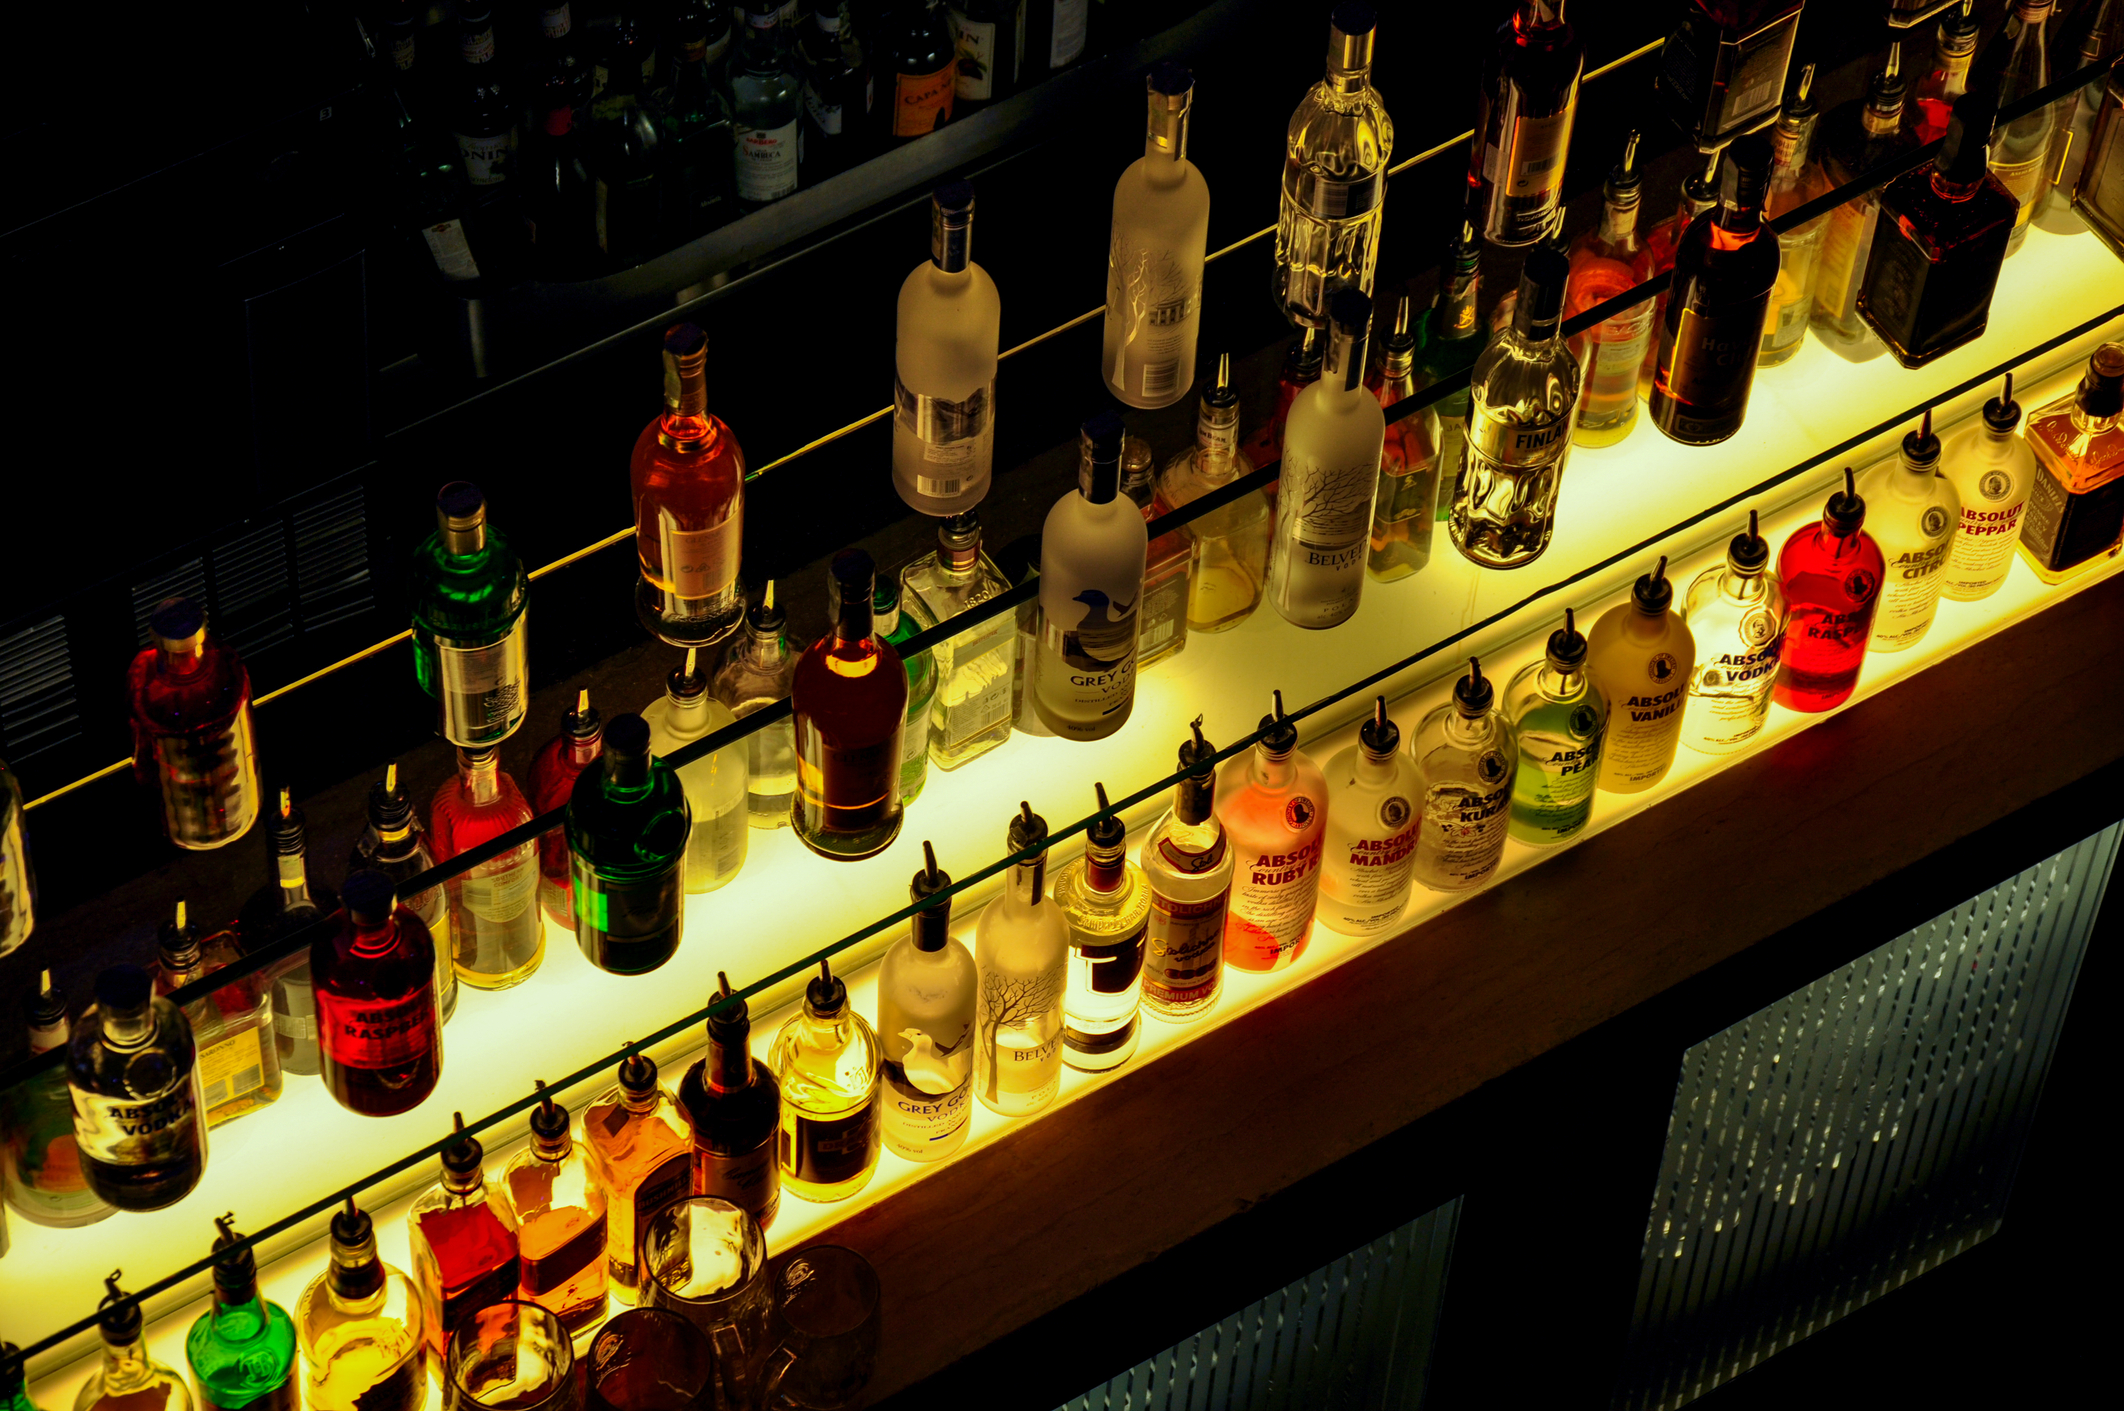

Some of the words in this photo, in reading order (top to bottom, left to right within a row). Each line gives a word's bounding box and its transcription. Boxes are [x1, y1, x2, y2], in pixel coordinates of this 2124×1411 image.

[1957, 518, 2017, 536] PEPPAR
[1070, 670, 1117, 687] GREY
[1252, 863, 1310, 886] RUBY
[1142, 978, 1199, 1002] PREMIUM
[897, 1101, 943, 1115] GREY
